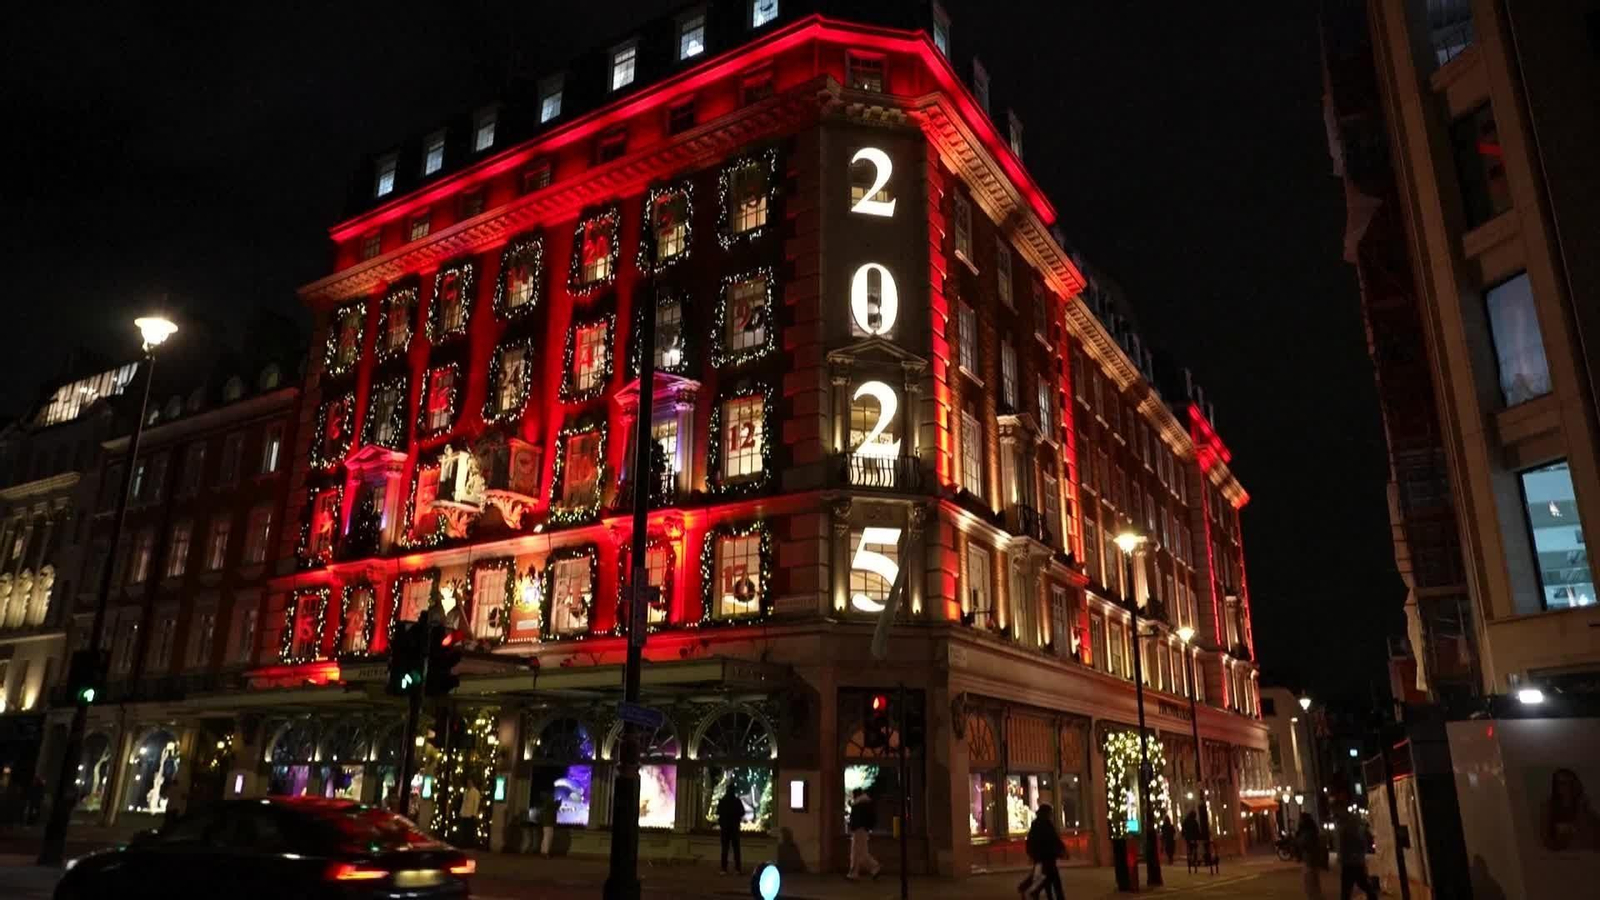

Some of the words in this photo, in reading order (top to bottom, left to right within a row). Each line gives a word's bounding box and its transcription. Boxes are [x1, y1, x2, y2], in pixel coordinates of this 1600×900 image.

[498, 365, 520, 392] 24
[849, 147, 902, 613] 2025
[729, 422, 756, 452] 12
